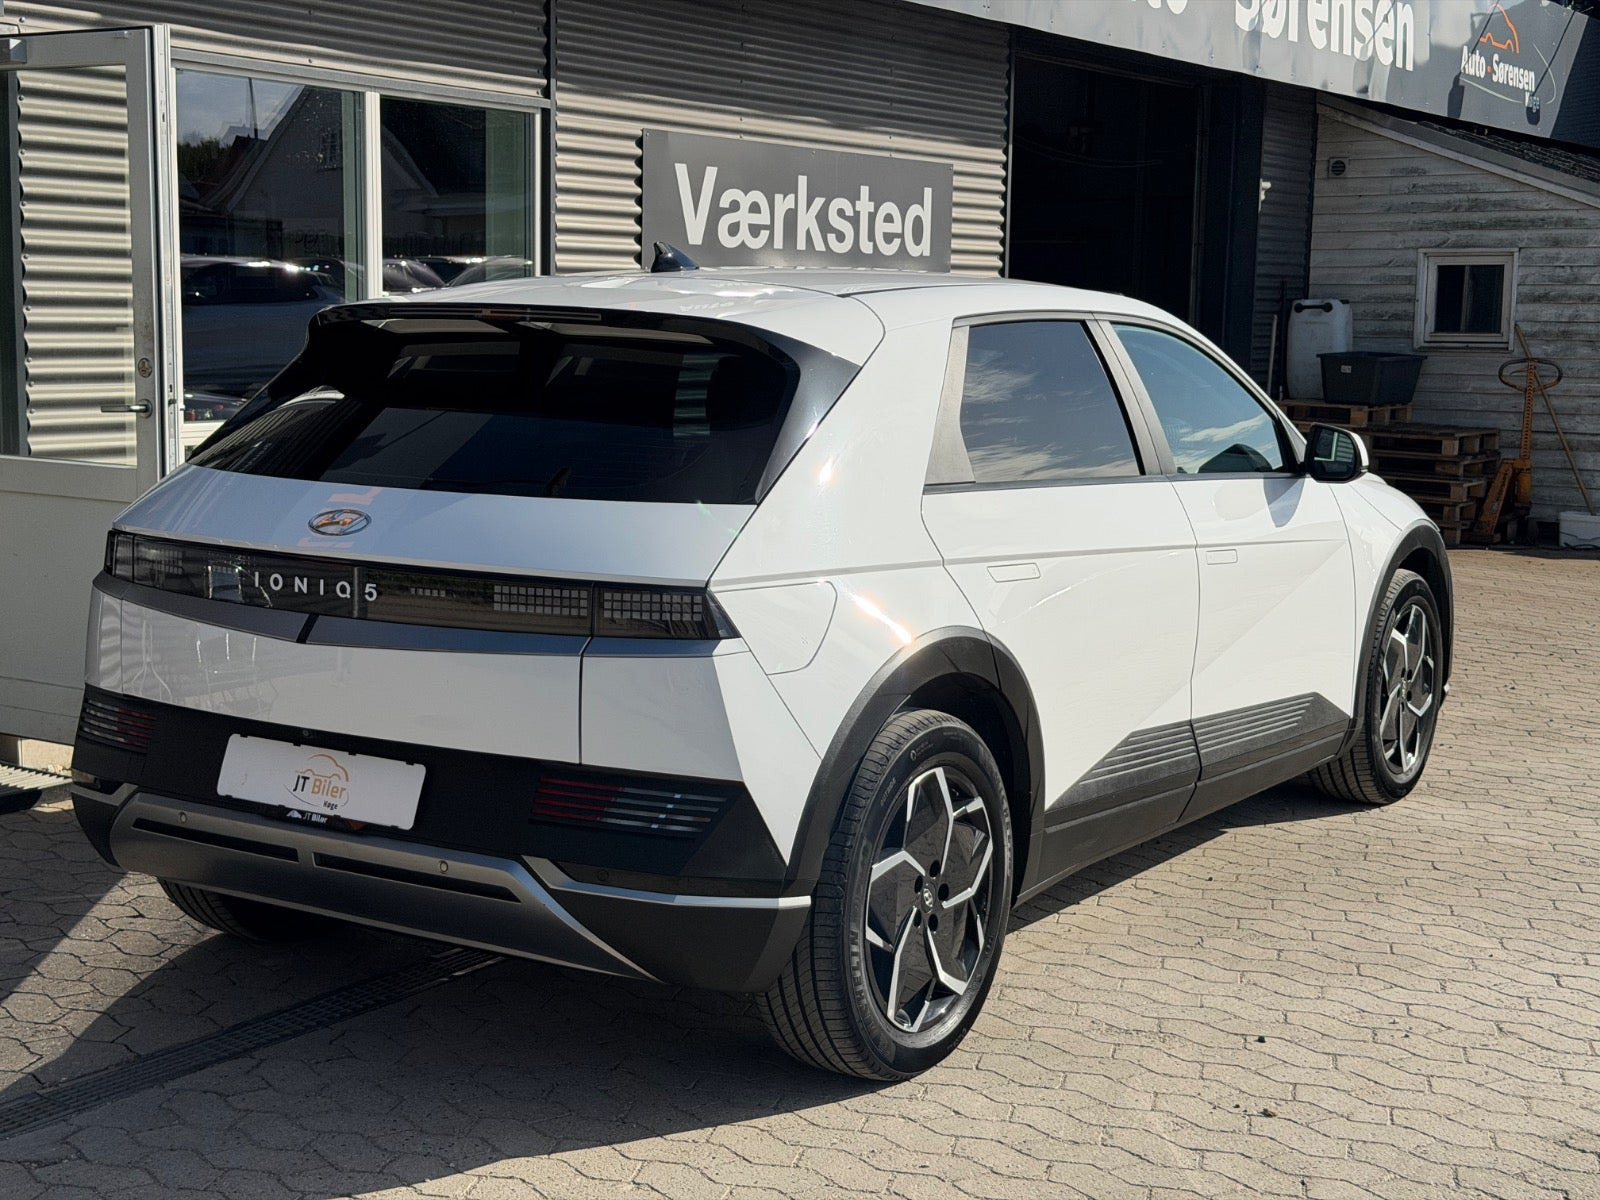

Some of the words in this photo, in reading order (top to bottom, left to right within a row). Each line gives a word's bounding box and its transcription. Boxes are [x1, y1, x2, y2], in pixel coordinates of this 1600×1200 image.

[1460, 45, 1486, 79] Auto
[1492, 53, 1536, 92] Sørensen
[674, 162, 933, 258] Værksted
[254, 571, 351, 599] IONIQ
[364, 583, 378, 602] 5
[293, 774, 310, 792] JT
[311, 779, 346, 799] Biler
